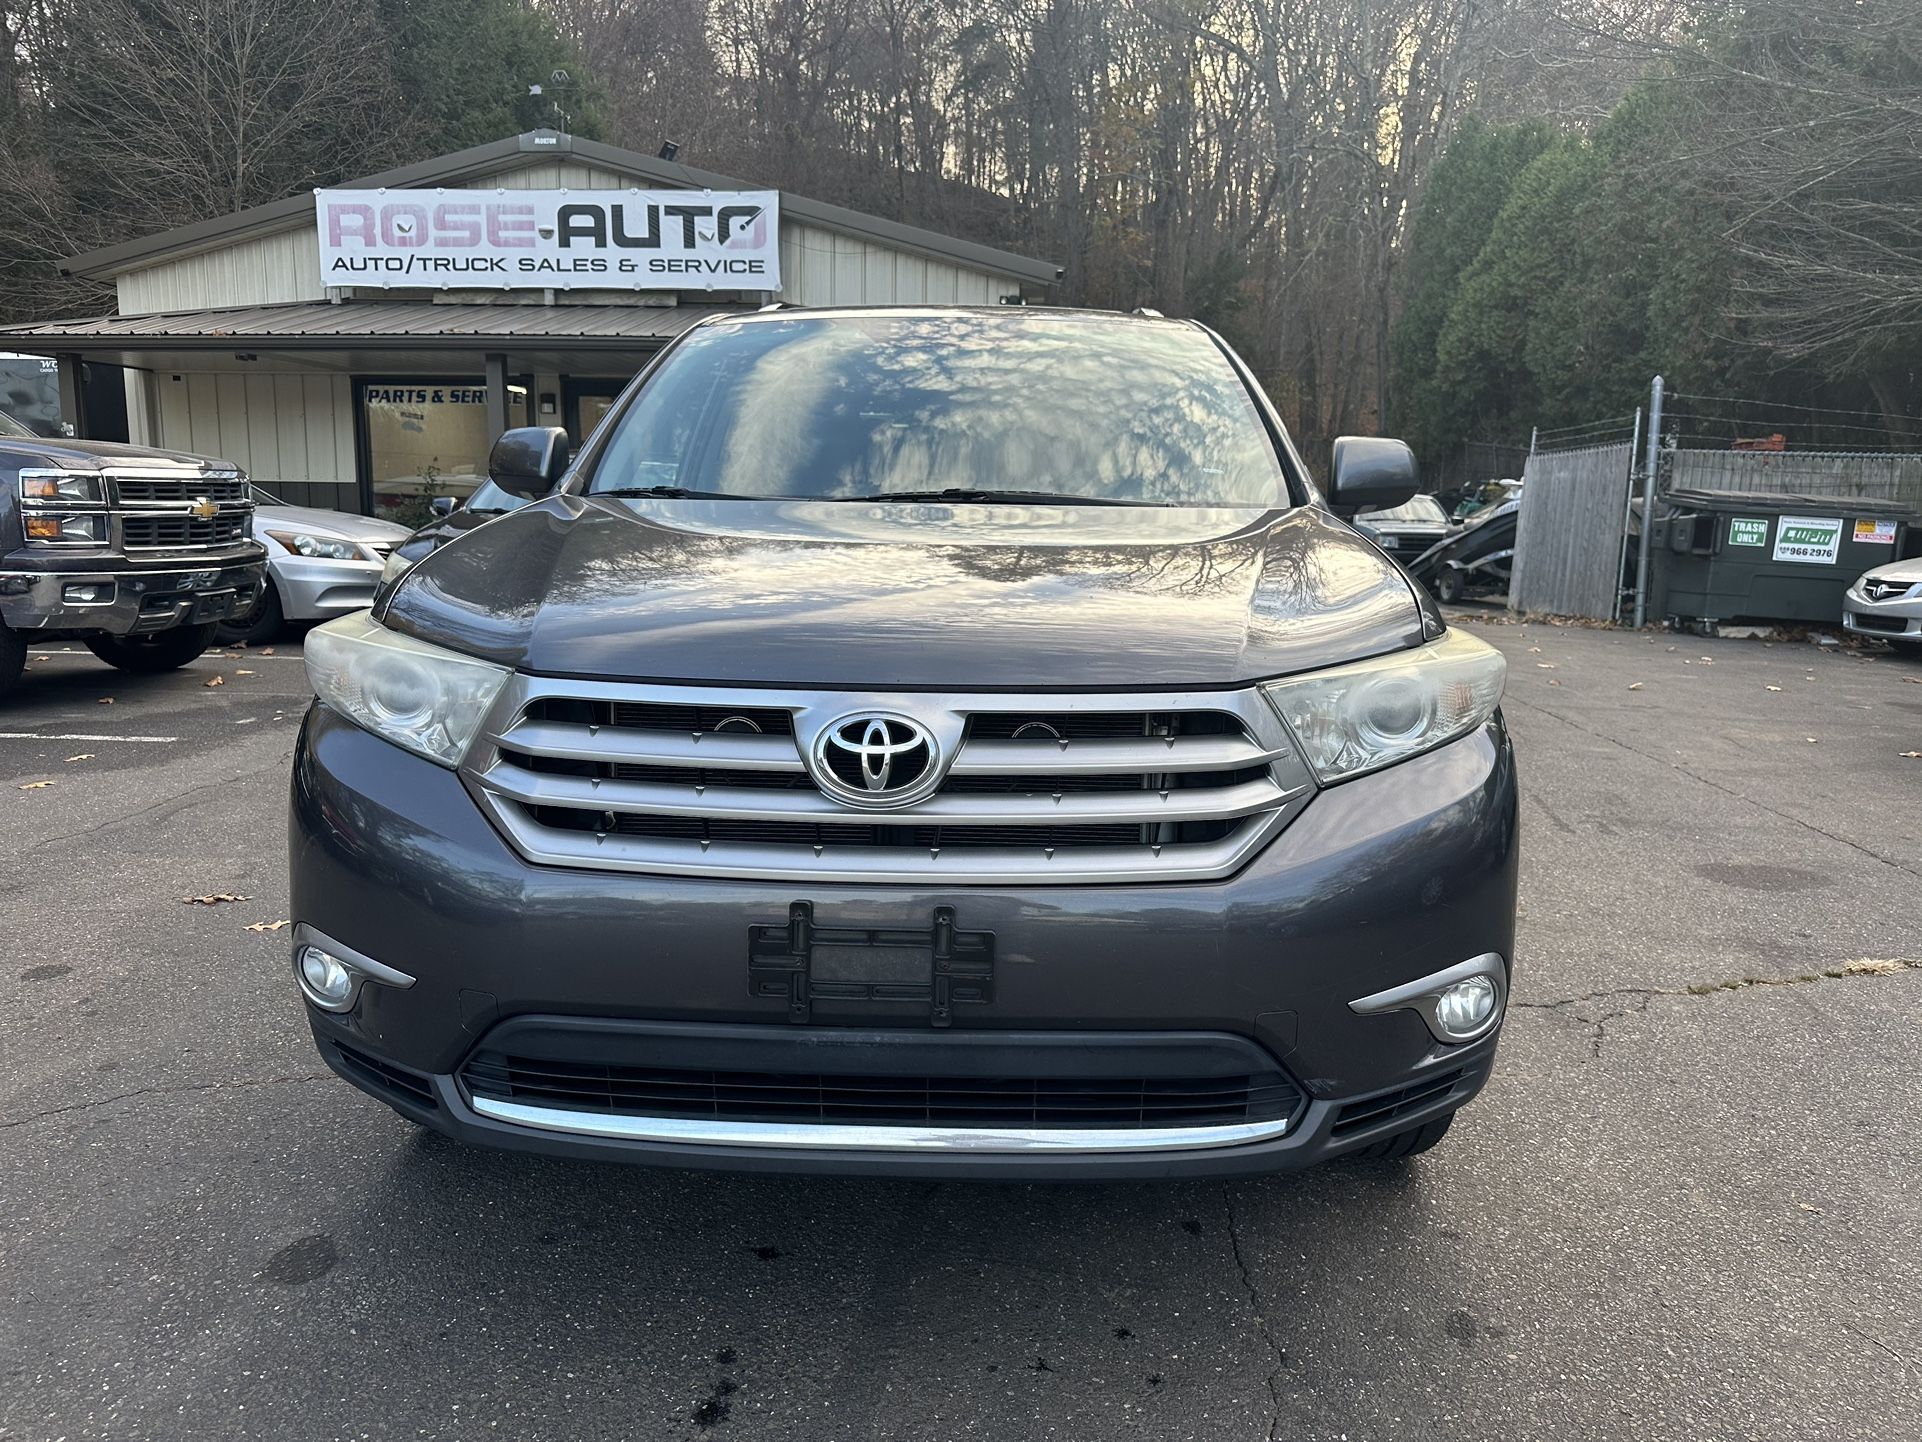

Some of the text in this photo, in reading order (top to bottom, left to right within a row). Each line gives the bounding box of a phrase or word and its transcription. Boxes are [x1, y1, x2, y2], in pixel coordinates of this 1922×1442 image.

[327, 203, 767, 250] ROSE AUTO
[331, 254, 765, 275] AUTO/TRUCK SALES & SERVICE
[368, 389, 427, 404] PARTS
[431, 389, 445, 404] &
[1734, 522, 1766, 533] TRASH
[1736, 533, 1758, 543] ONLY
[1790, 546, 1809, 556] 966
[1809, 548, 1833, 558] 2976
